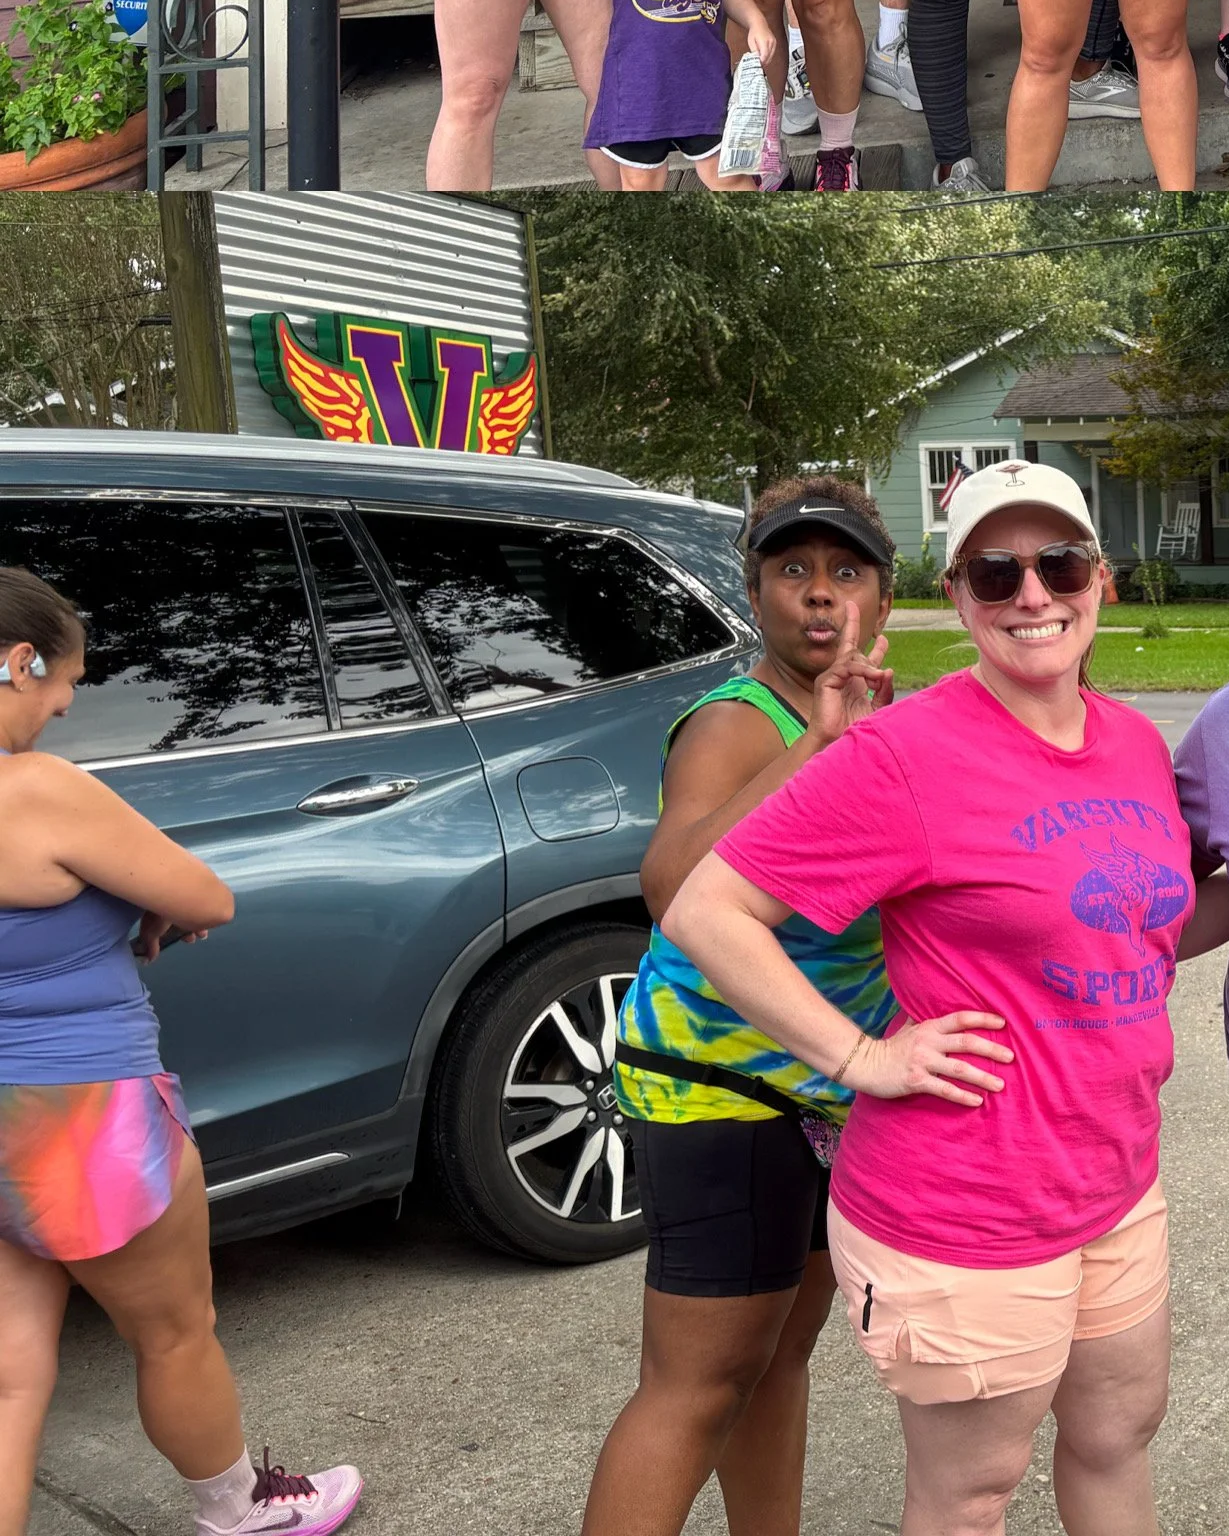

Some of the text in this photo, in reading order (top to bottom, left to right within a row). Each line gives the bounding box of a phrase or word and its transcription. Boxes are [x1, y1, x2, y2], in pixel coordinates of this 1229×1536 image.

[115, 0, 148, 10] SECURIT
[344, 321, 488, 452] V
[1009, 798, 1176, 854] VARSITY
[1156, 881, 1185, 899] 2000
[1040, 951, 1177, 1006] SPORT
[1071, 1018, 1110, 1030] ROUGE
[1115, 1007, 1161, 1028] MANDEVILLE
